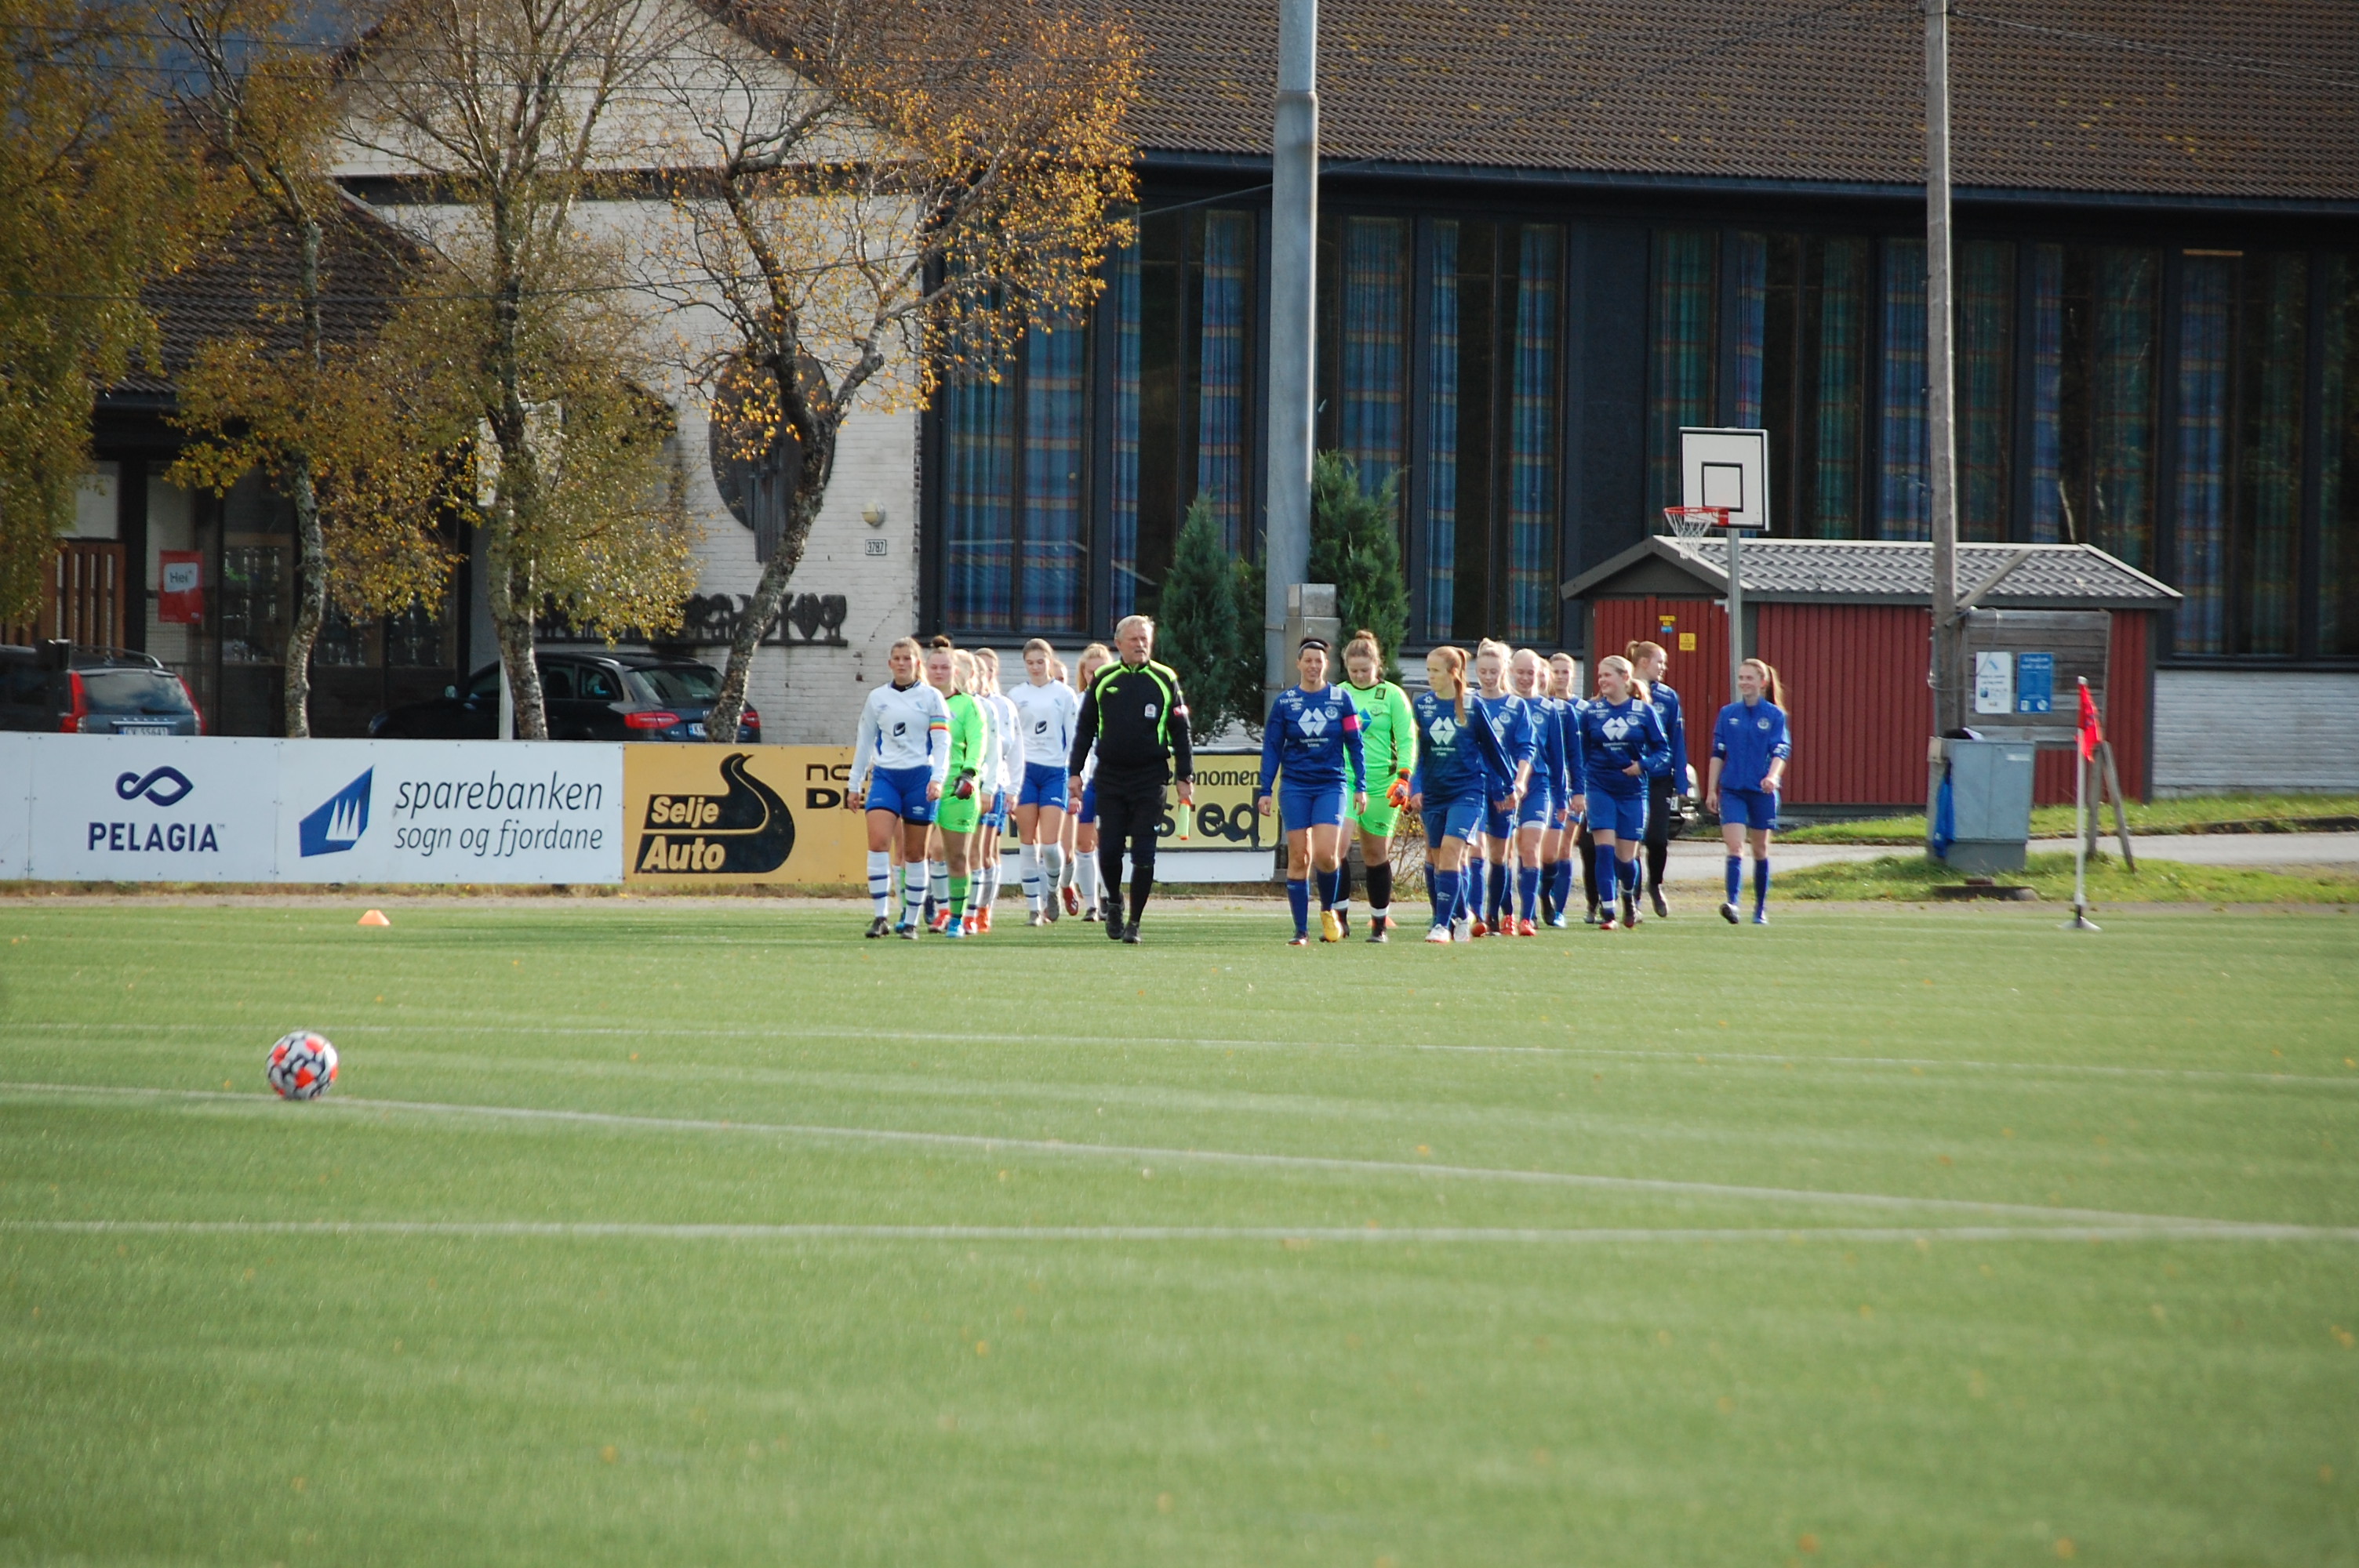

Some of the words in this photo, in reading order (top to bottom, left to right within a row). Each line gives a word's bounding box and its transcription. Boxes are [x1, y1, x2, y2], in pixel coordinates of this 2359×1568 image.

[394, 770, 603, 819] sparebanken
[651, 796, 720, 828] Selje
[88, 822, 219, 852] PELAGIA
[394, 827, 452, 857] sogn
[460, 827, 490, 857] og
[493, 818, 603, 857] fjordane
[641, 835, 726, 871] Auto
